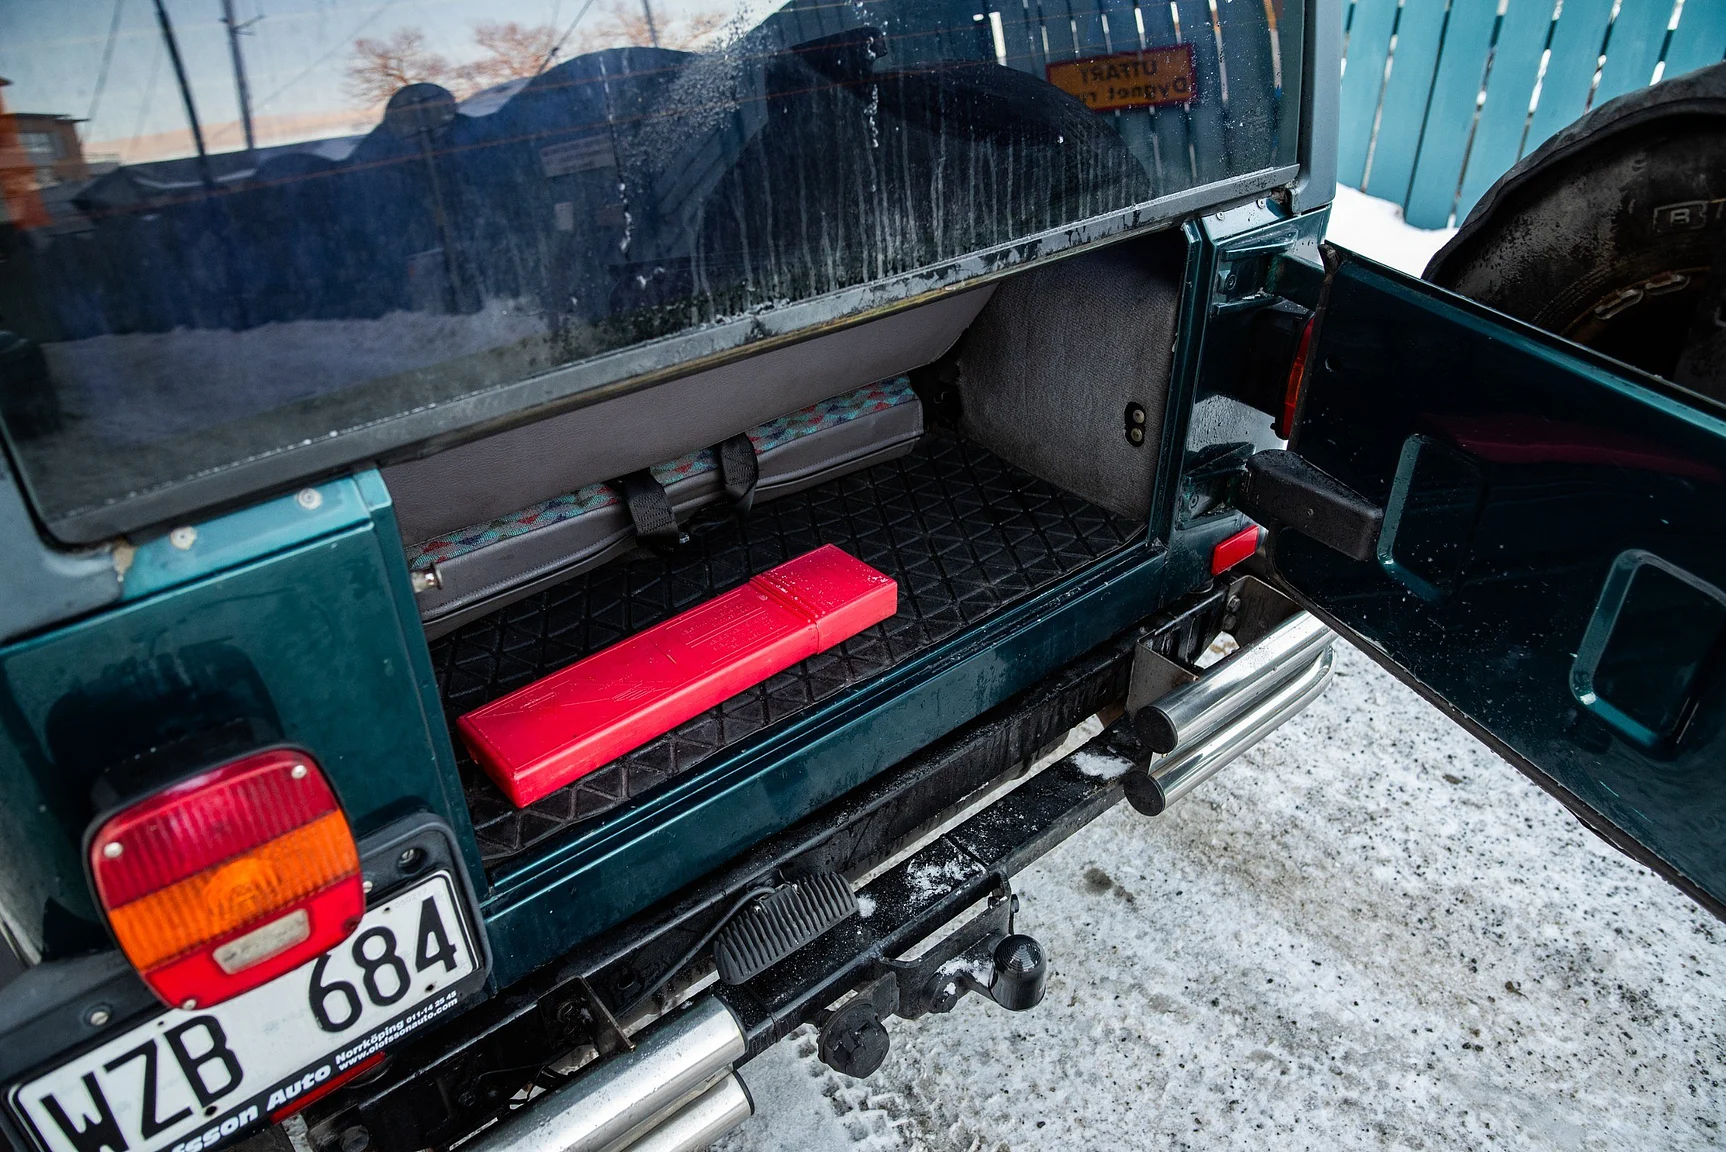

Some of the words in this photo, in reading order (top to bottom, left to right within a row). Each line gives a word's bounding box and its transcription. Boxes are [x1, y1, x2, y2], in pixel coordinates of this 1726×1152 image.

[39, 1014, 244, 1152] WZB
[308, 895, 458, 1033] 684
[335, 1019, 405, 1065] Norrköping
[406, 1005, 434, 1023] 011-14
[434, 997, 445, 1006] 25
[446, 990, 457, 1000] 45
[338, 997, 459, 1071] www.olofssonauto.com
[267, 1064, 332, 1112] Auto
